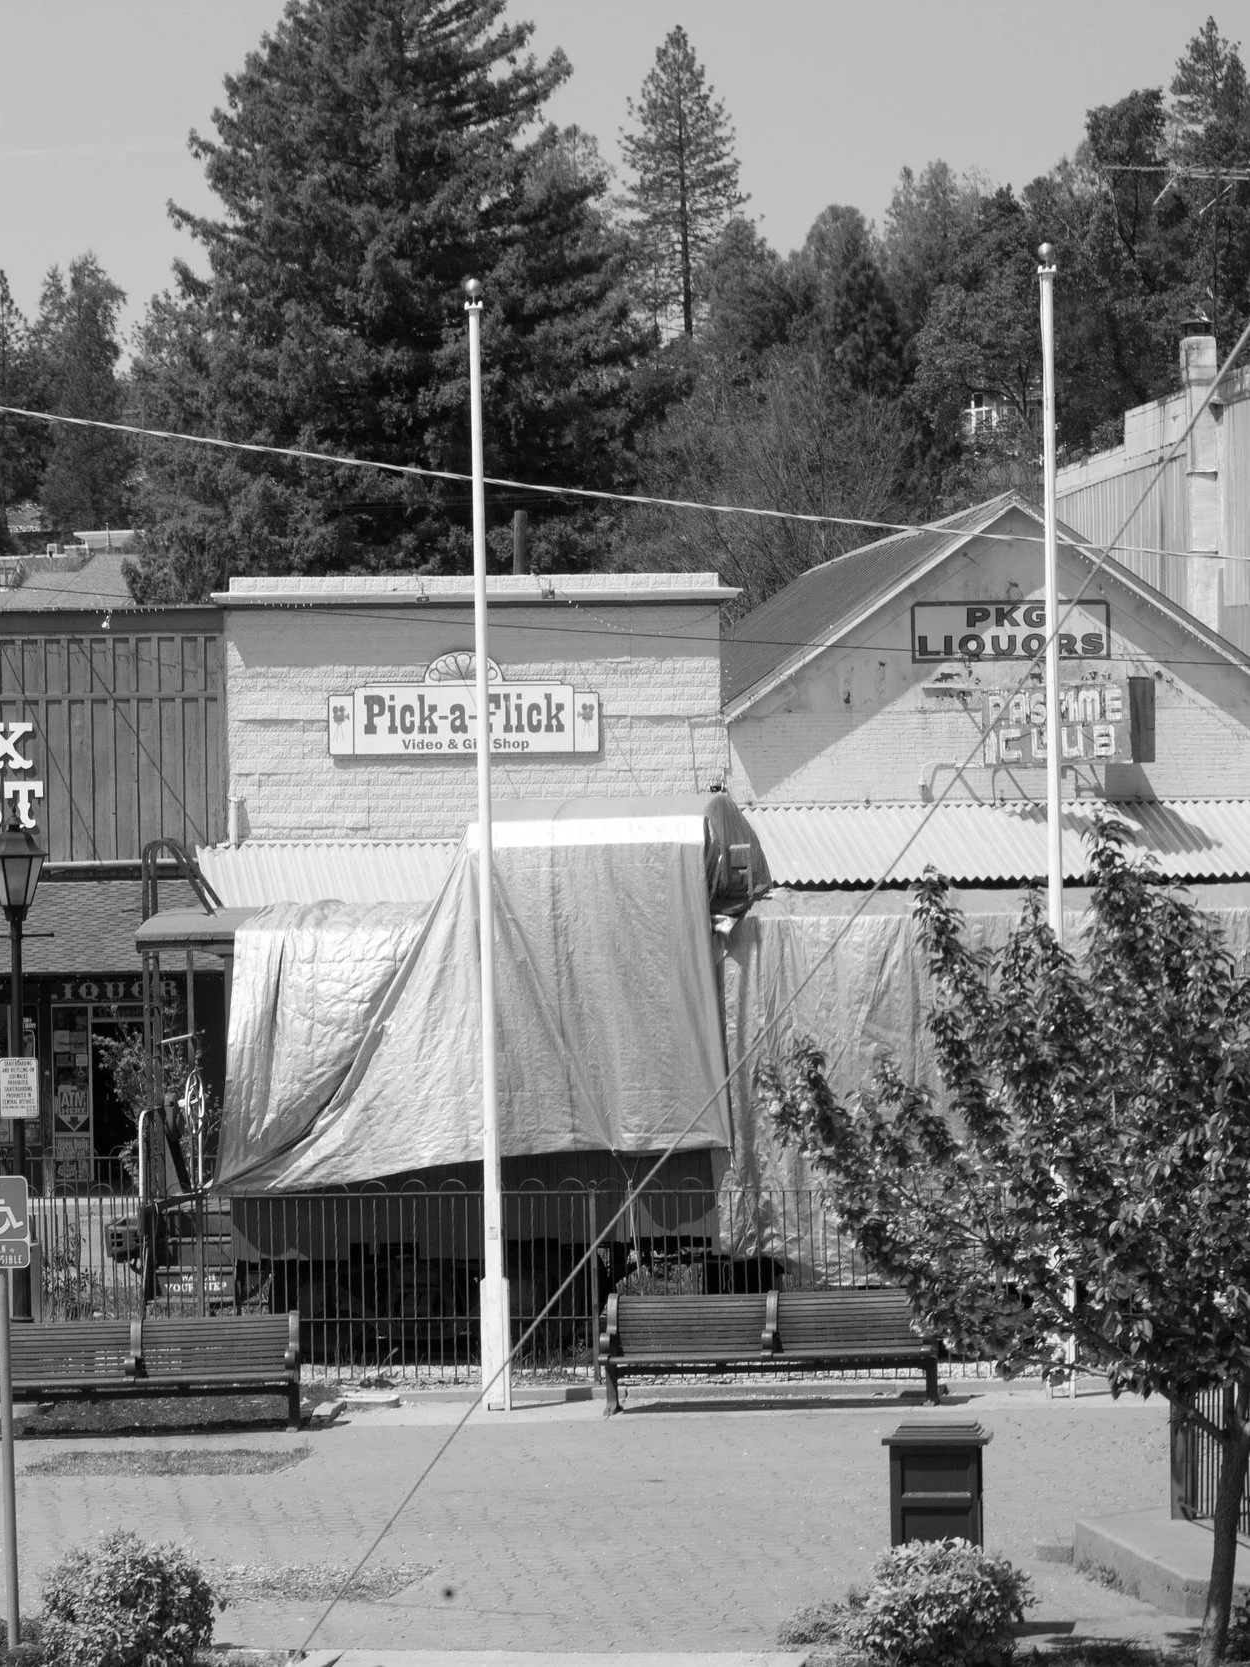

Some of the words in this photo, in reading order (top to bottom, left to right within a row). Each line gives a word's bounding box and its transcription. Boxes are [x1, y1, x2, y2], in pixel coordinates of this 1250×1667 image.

[966, 605, 1046, 628] PKG
[918, 633, 1105, 657] LIQUORS
[402, 738, 443, 750] Video
[447, 738, 459, 750] &
[493, 738, 530, 751] Shop
[1000, 724, 1116, 763] CLUB
[51, 980, 178, 1001] IQUOR
[61, 1092, 86, 1107] ATM
[61, 1107, 87, 1115] HERE
